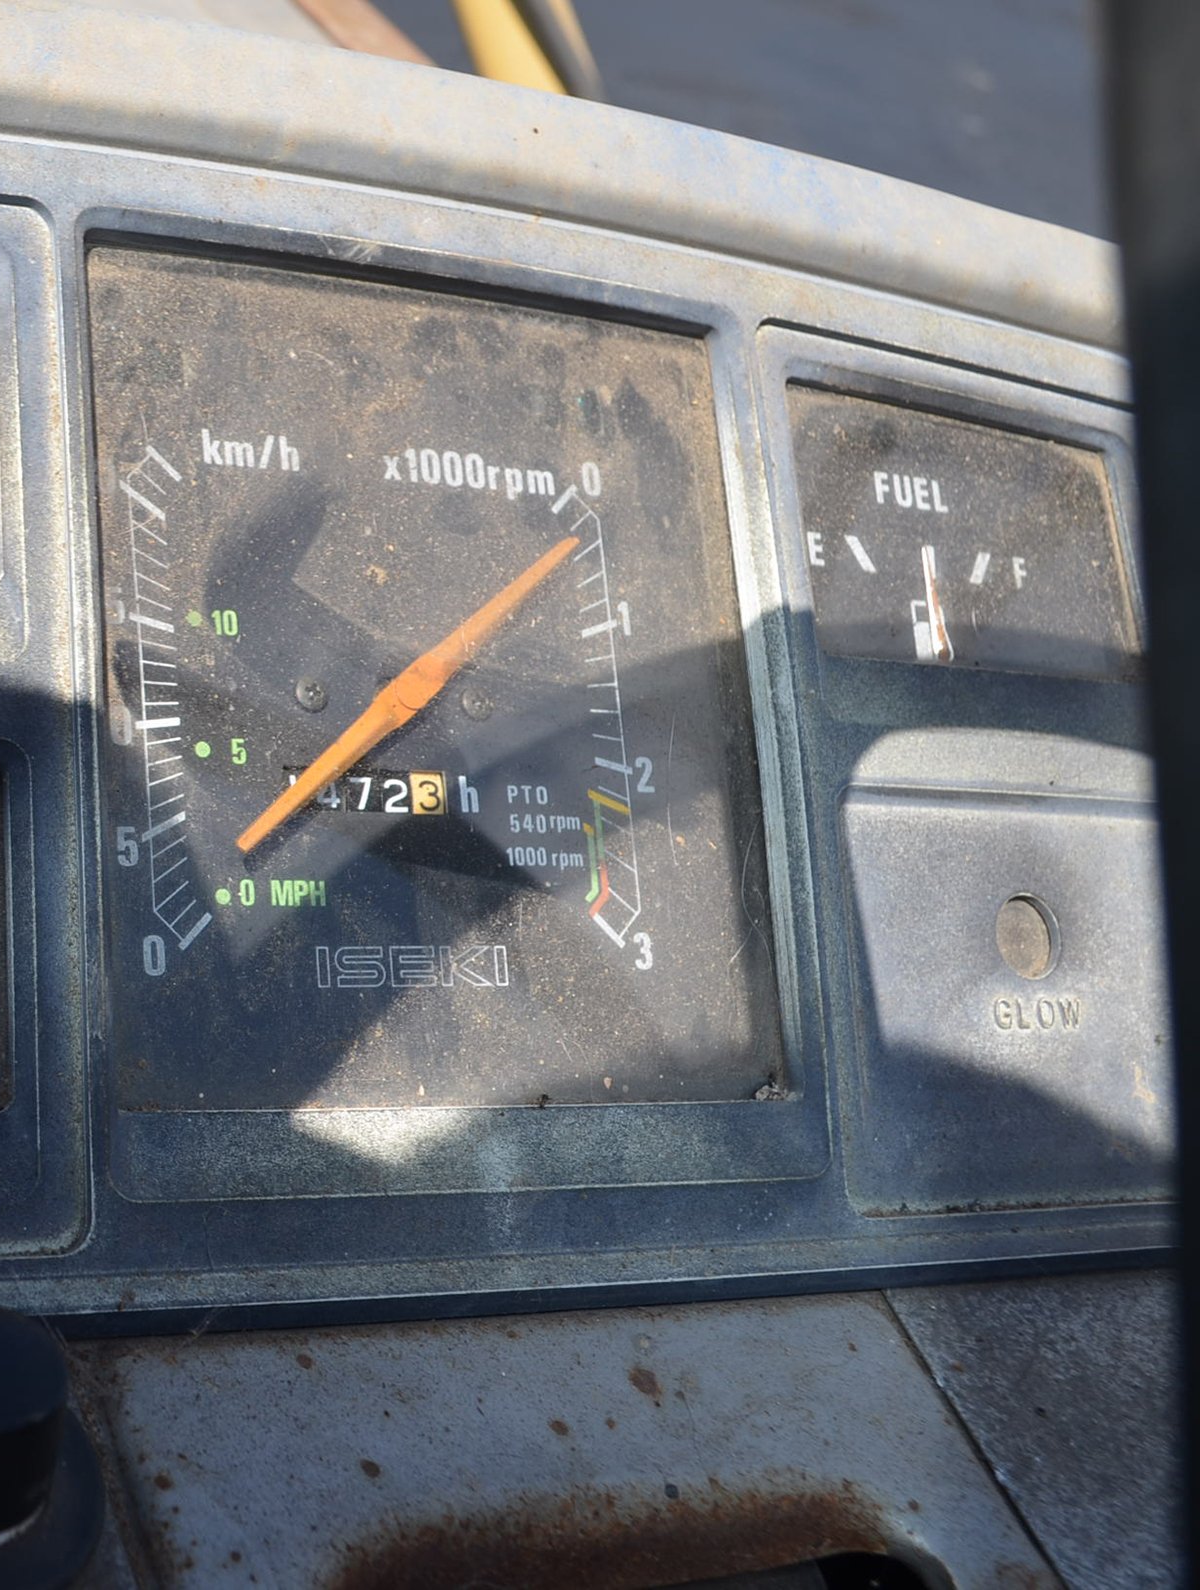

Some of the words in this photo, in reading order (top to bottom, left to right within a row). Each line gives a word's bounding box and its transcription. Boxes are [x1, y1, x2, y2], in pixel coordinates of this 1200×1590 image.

[201, 428, 300, 472] km/h
[383, 447, 556, 500] x1000rpm
[581, 460, 602, 497] 0
[873, 470, 950, 514] FUEL
[806, 530, 825, 567] E
[1012, 556, 1028, 590] F
[210, 609, 239, 636] 10
[618, 601, 632, 636] 1
[231, 738, 248, 765] 5
[635, 755, 656, 793] 2
[288, 774, 443, 814] 4723
[457, 774, 480, 814] h
[506, 785, 549, 805] PTO
[509, 813, 547, 834] 540
[550, 814, 581, 834] rpm
[116, 826, 138, 867] 5
[506, 846, 548, 867] 1000
[551, 851, 585, 870] rpm
[240, 878, 255, 907] 0
[271, 880, 327, 907] MPH
[142, 935, 166, 977] 0
[315, 945, 510, 989] ISEKI
[634, 933, 654, 971] 3
[993, 998, 1082, 1031] GLOW
